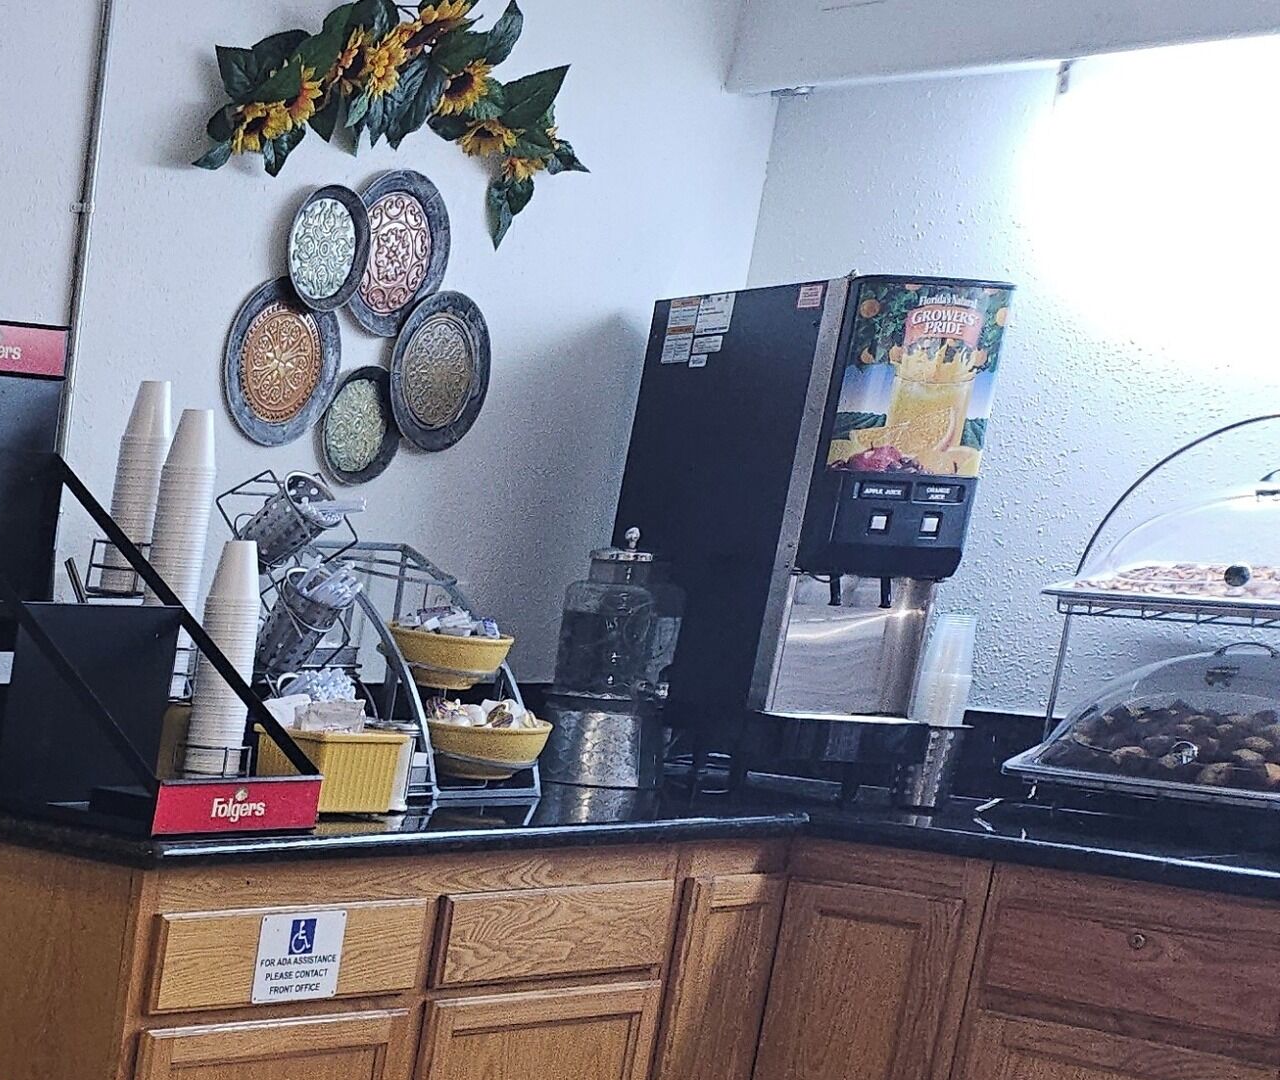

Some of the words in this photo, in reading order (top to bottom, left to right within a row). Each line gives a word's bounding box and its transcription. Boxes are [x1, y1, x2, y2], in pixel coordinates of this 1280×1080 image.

[918, 294, 951, 306] Florida's
[924, 321, 964, 335] PRIDE
[210, 798, 266, 822] Folgers
[260, 957, 276, 967] FOR
[277, 957, 292, 967] ADA
[293, 955, 337, 965] ASSISTANCE
[265, 970, 294, 981] PLEASE
[295, 968, 328, 980] CONTACT
[269, 984, 294, 995] FRONT
[294, 982, 321, 993] OFFICE
